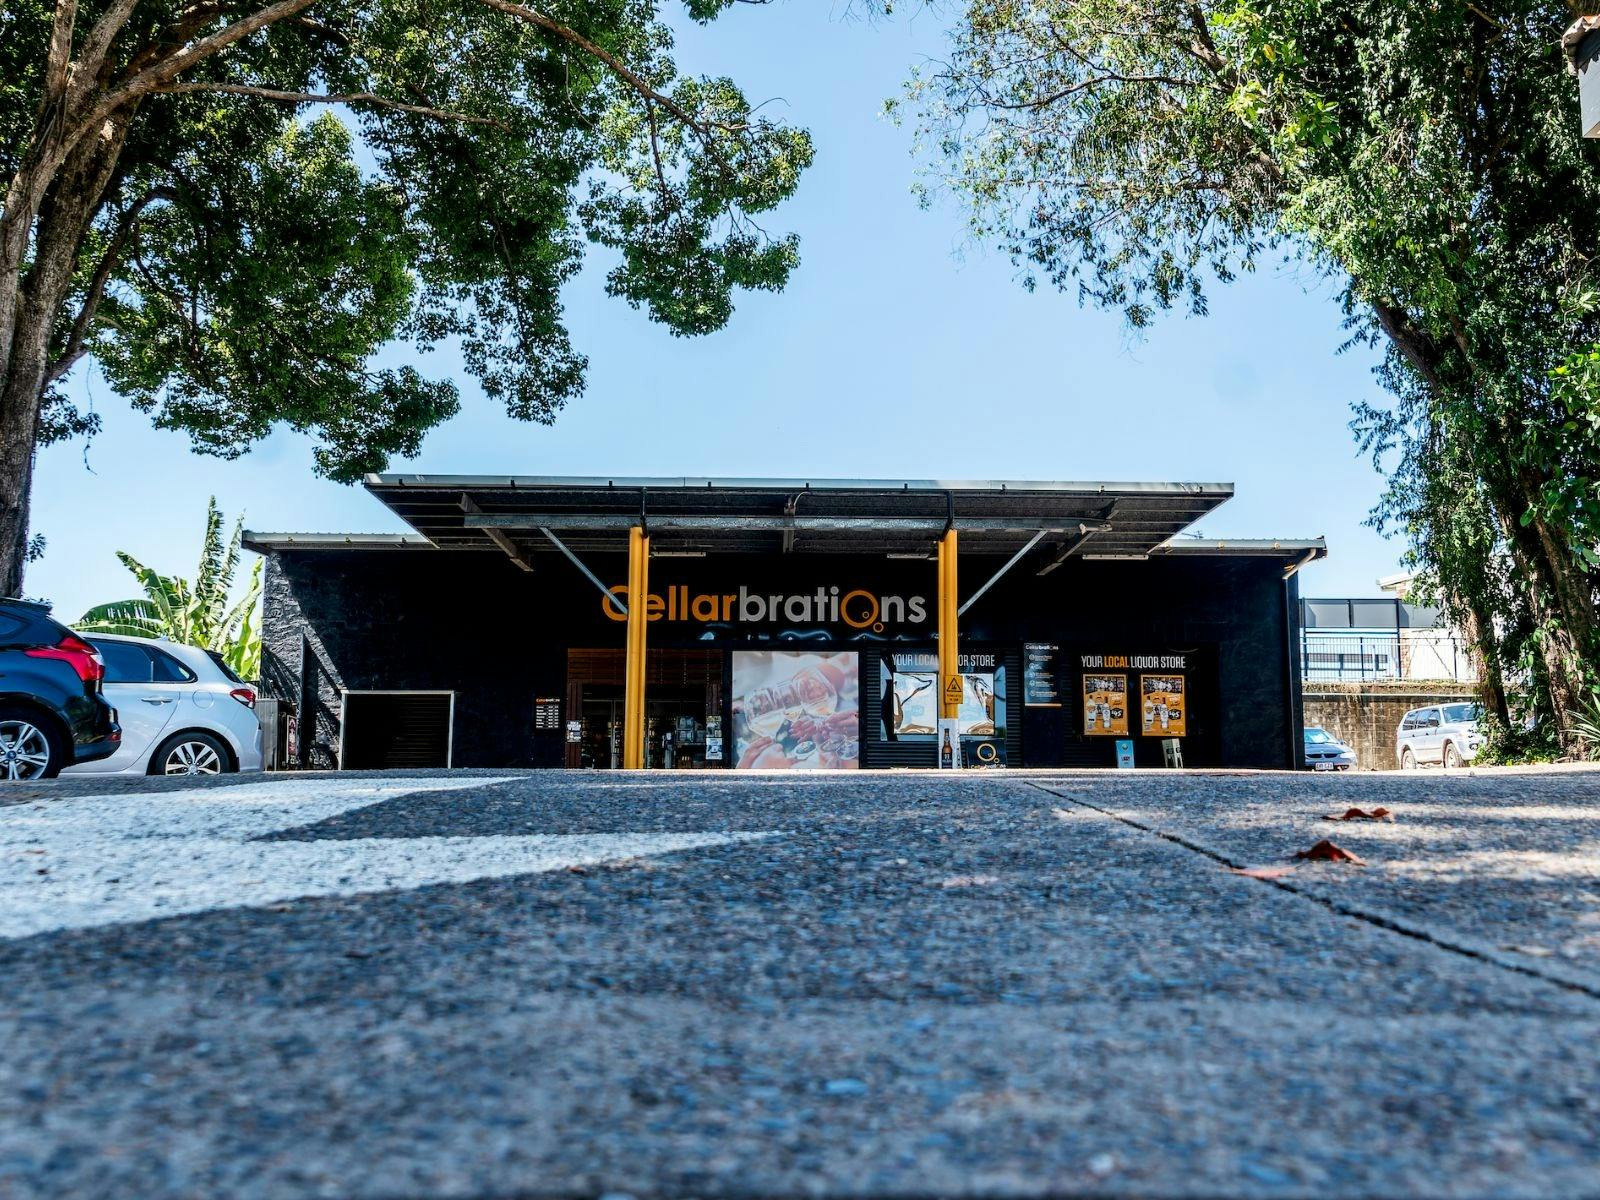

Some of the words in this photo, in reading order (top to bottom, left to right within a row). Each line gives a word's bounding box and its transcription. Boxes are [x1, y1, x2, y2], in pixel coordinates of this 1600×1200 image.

[891, 653, 913, 666] YOUR
[914, 654, 939, 666] LOCAL
[970, 654, 996, 667] STORE
[1081, 655, 1103, 668] YOUR
[1104, 655, 1129, 668] LOCAL
[1130, 656, 1159, 669] LIQUOR
[1160, 656, 1186, 669] STORE
